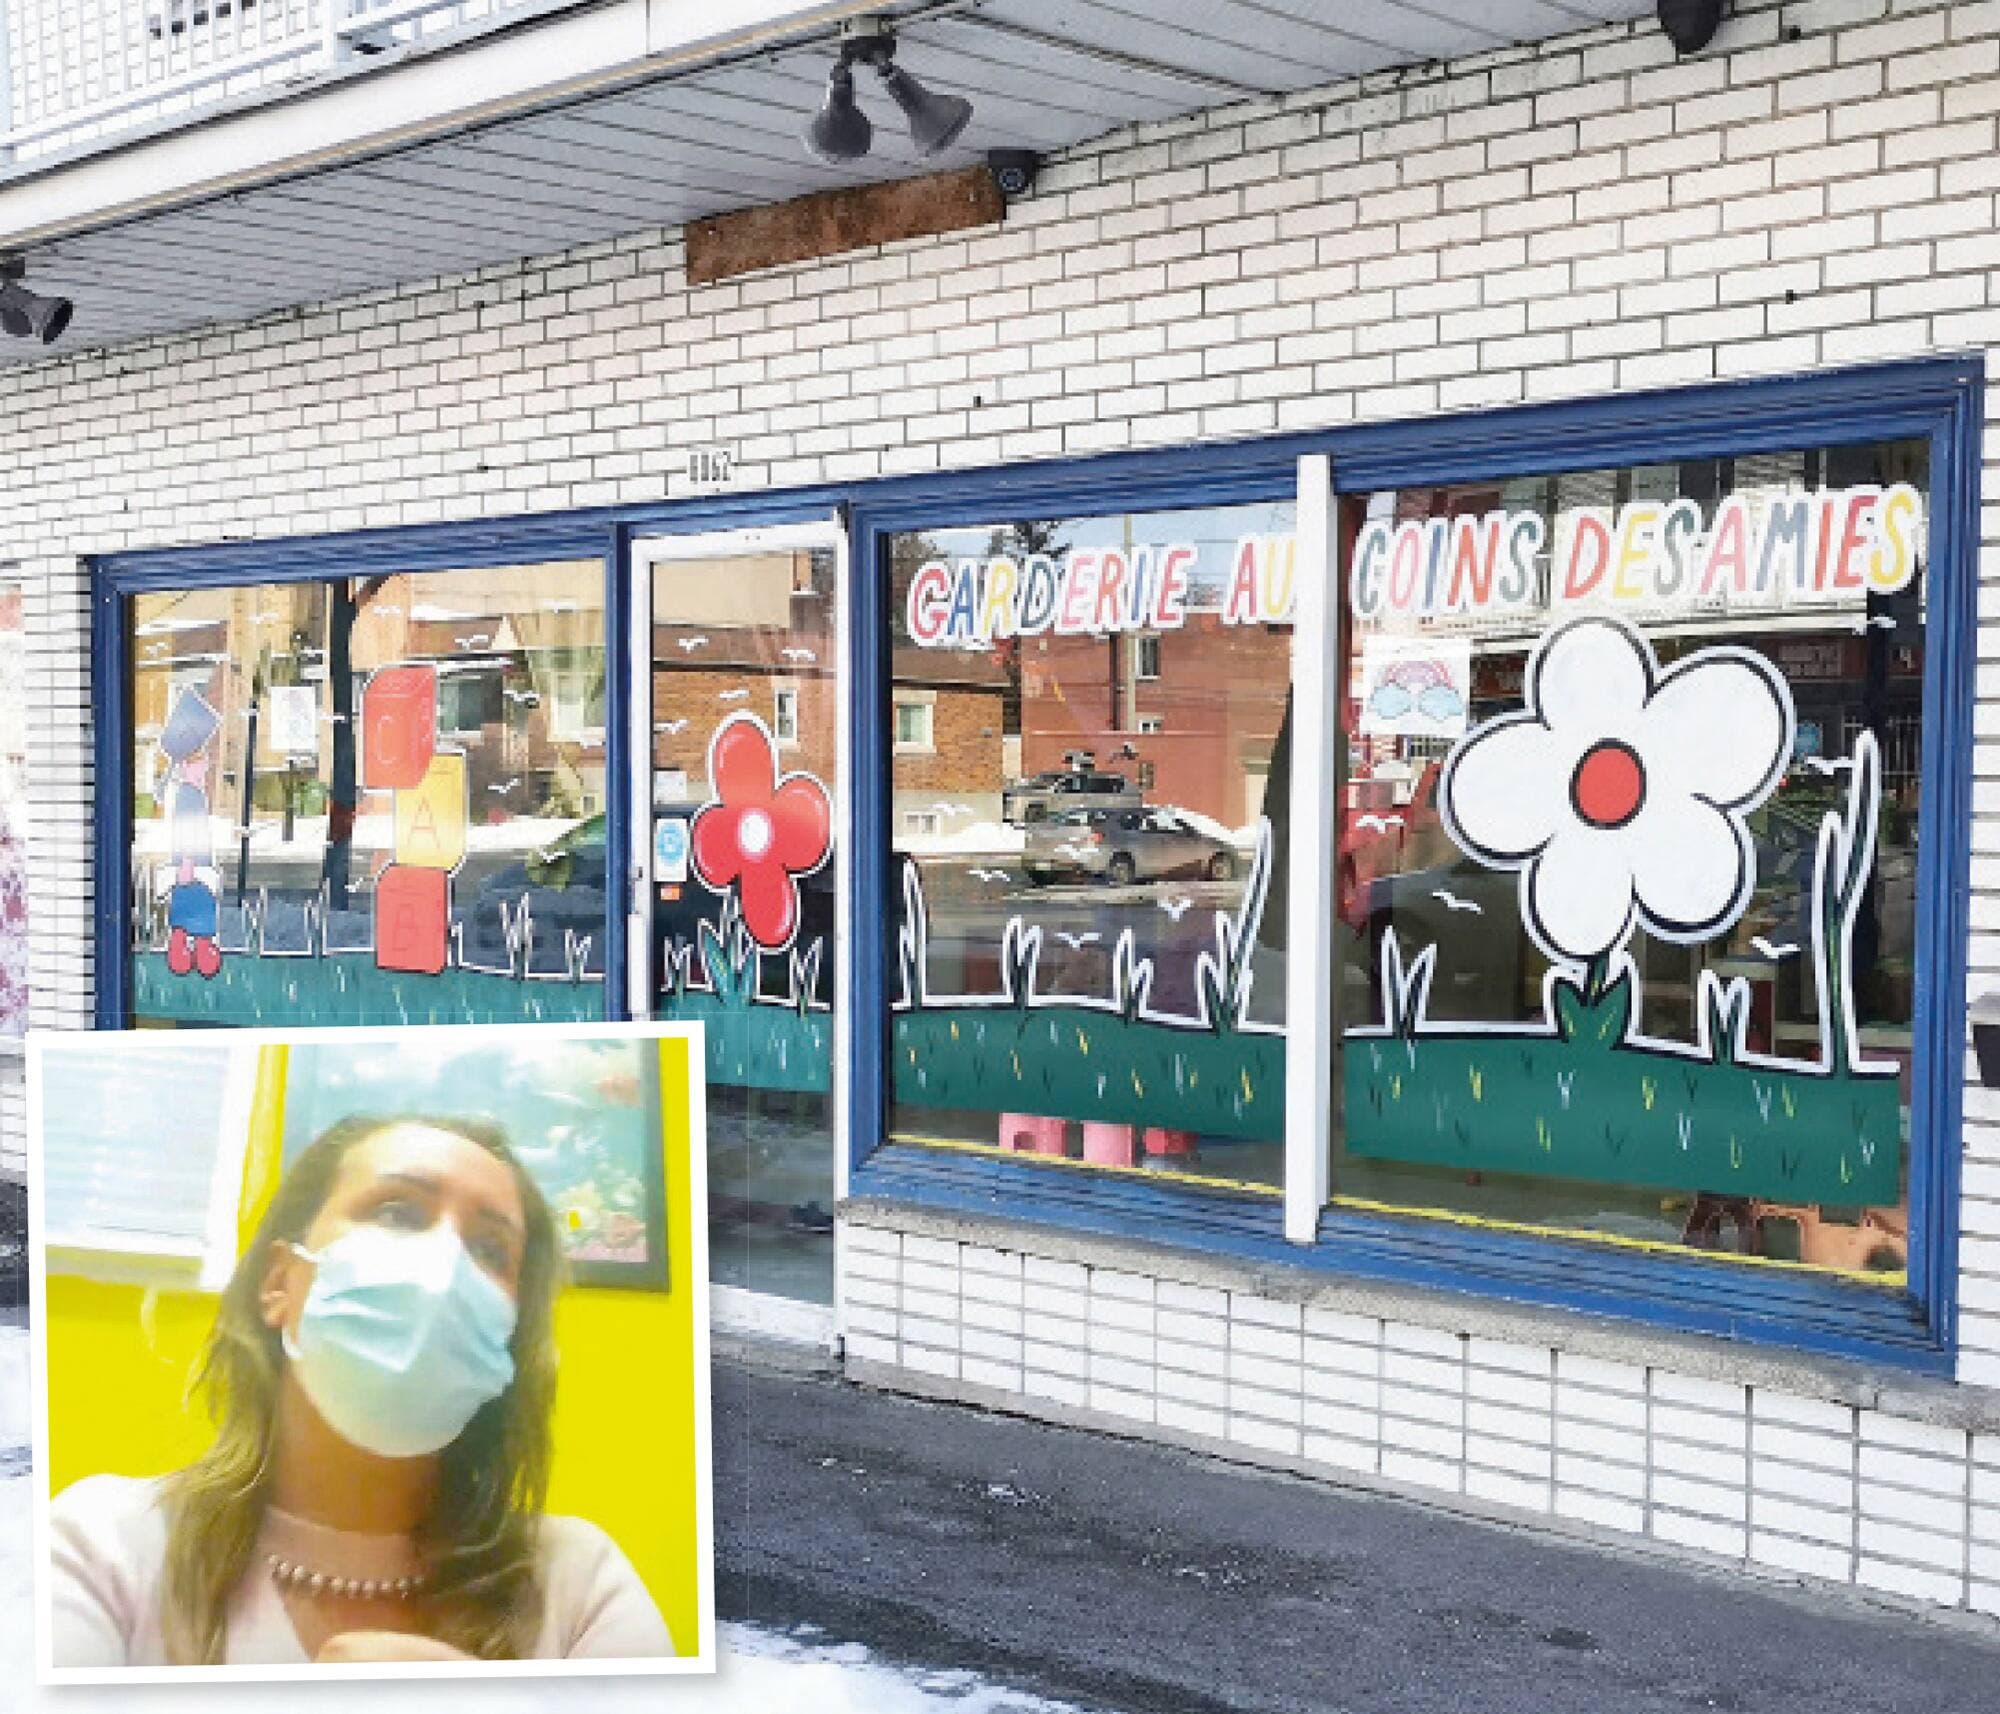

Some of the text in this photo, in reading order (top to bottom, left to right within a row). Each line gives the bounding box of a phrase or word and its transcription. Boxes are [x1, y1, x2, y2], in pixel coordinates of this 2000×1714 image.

[909, 546, 1196, 642] GARDERIE
[1226, 538, 1297, 622] AU
[1356, 517, 1540, 613] COINS
